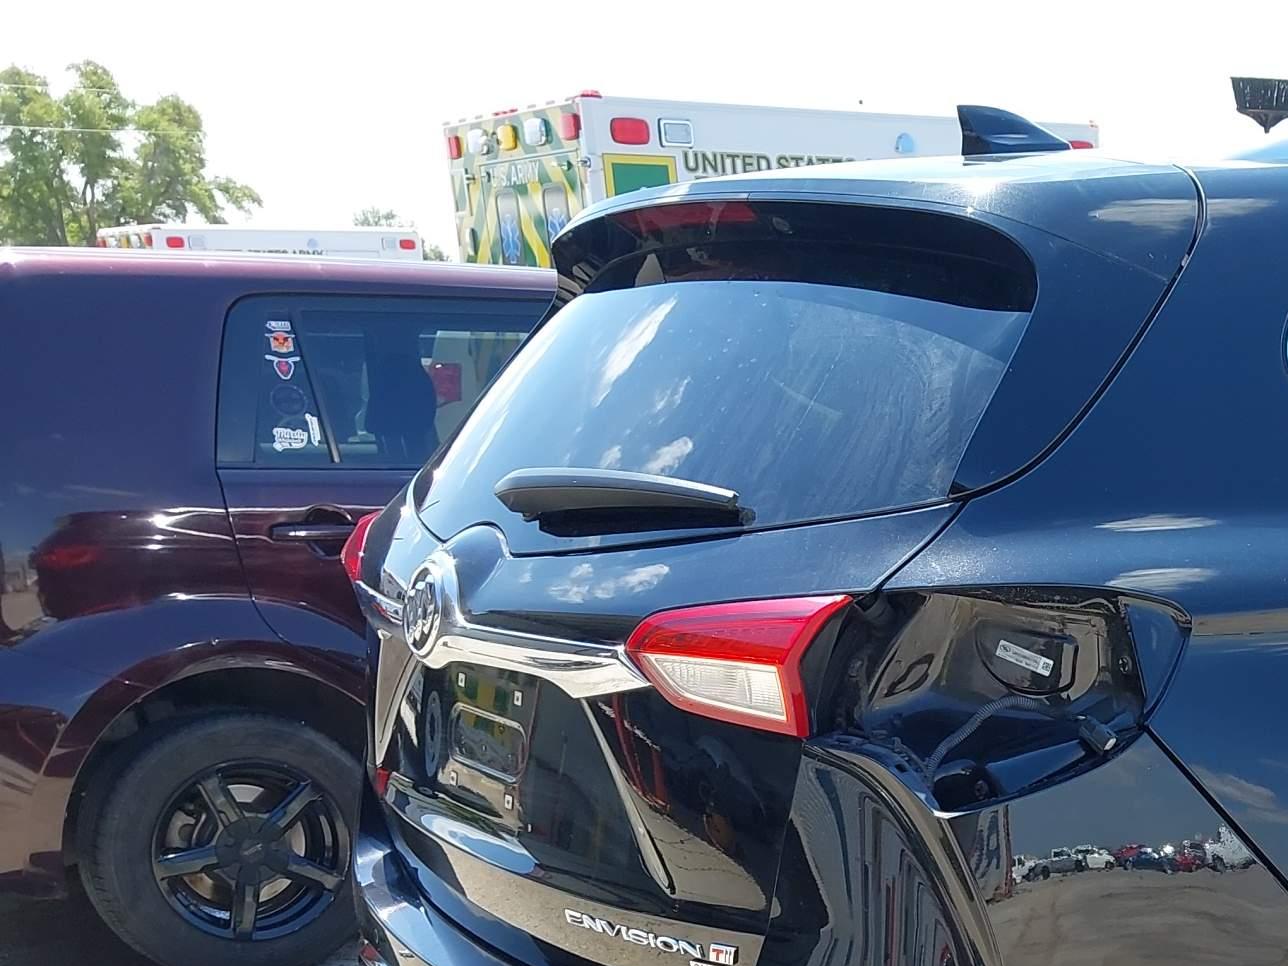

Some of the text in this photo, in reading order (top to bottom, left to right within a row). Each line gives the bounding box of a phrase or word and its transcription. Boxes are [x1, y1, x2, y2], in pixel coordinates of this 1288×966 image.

[511, 160, 539, 185] ARMY
[684, 150, 771, 173] UNITED
[564, 908, 703, 959] ENVISION
